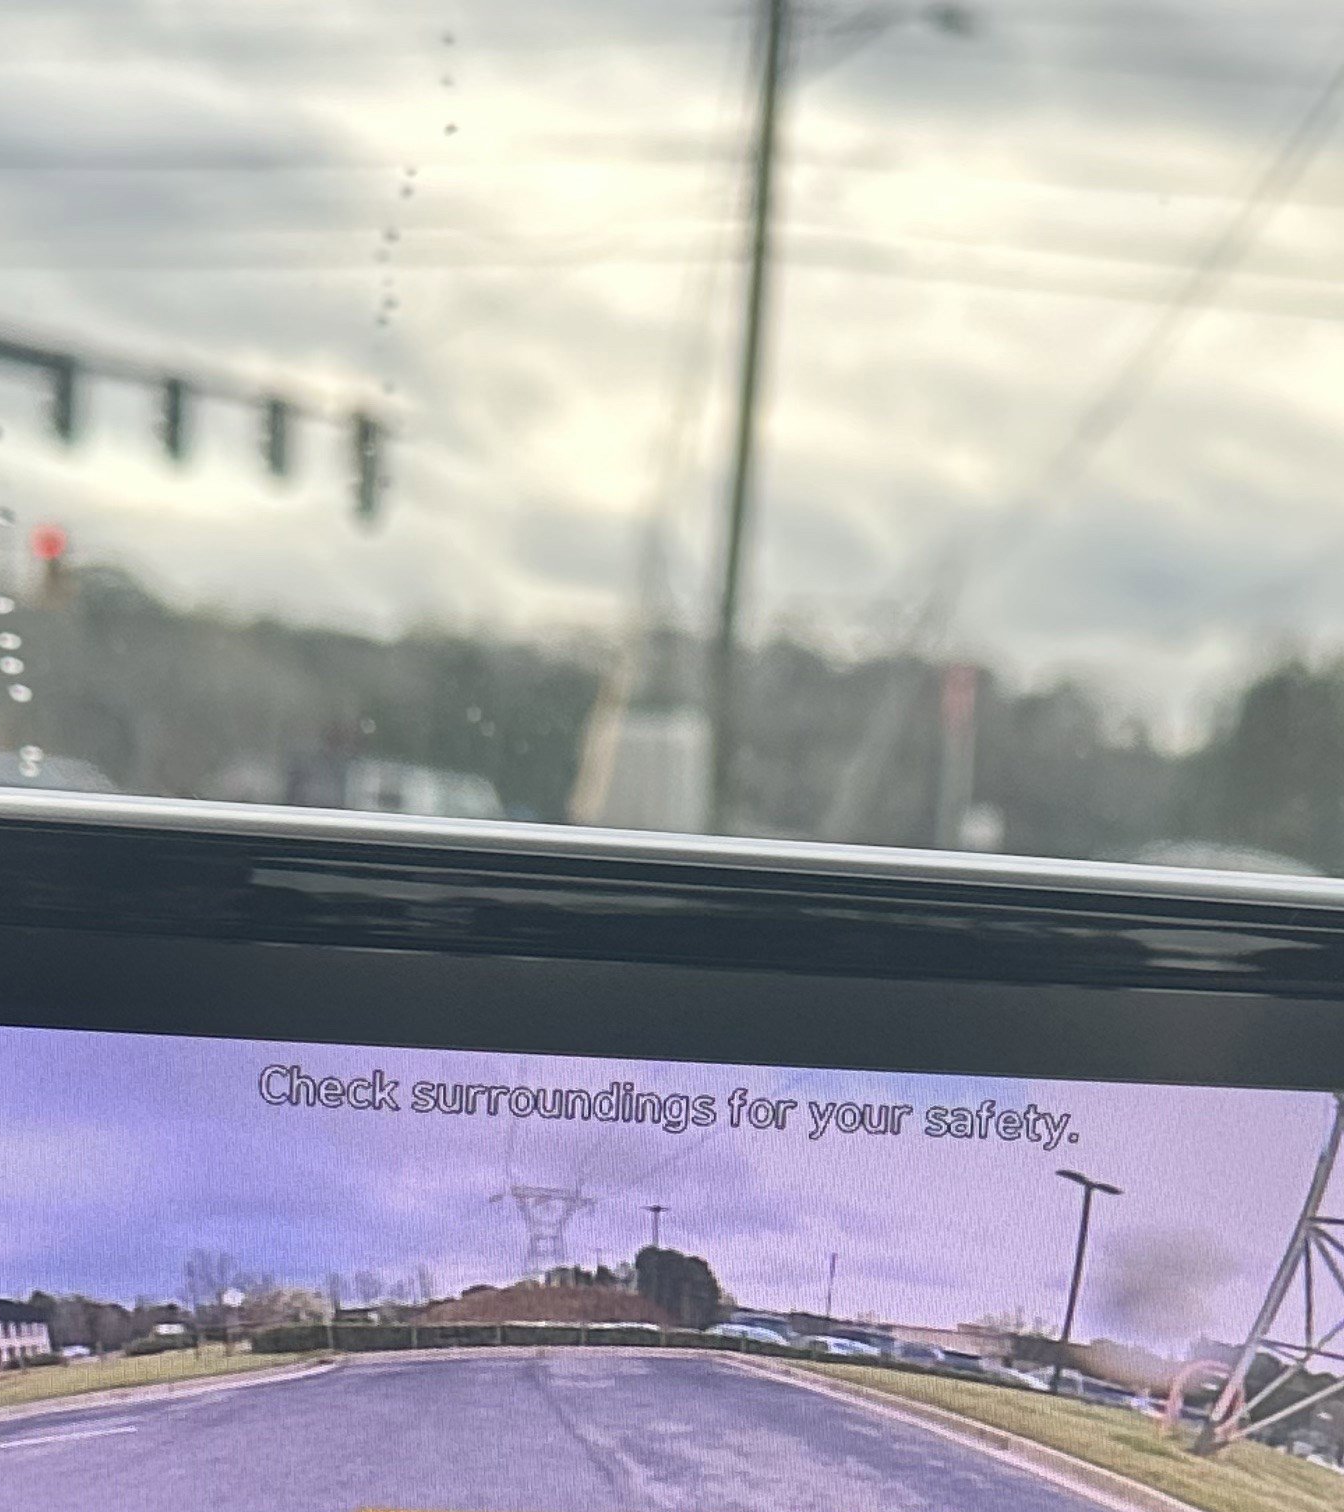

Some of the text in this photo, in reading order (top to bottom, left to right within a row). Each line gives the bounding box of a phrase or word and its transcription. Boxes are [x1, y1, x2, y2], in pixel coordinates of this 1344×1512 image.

[258, 1063, 1081, 1151] Check surroundings for your safety.
